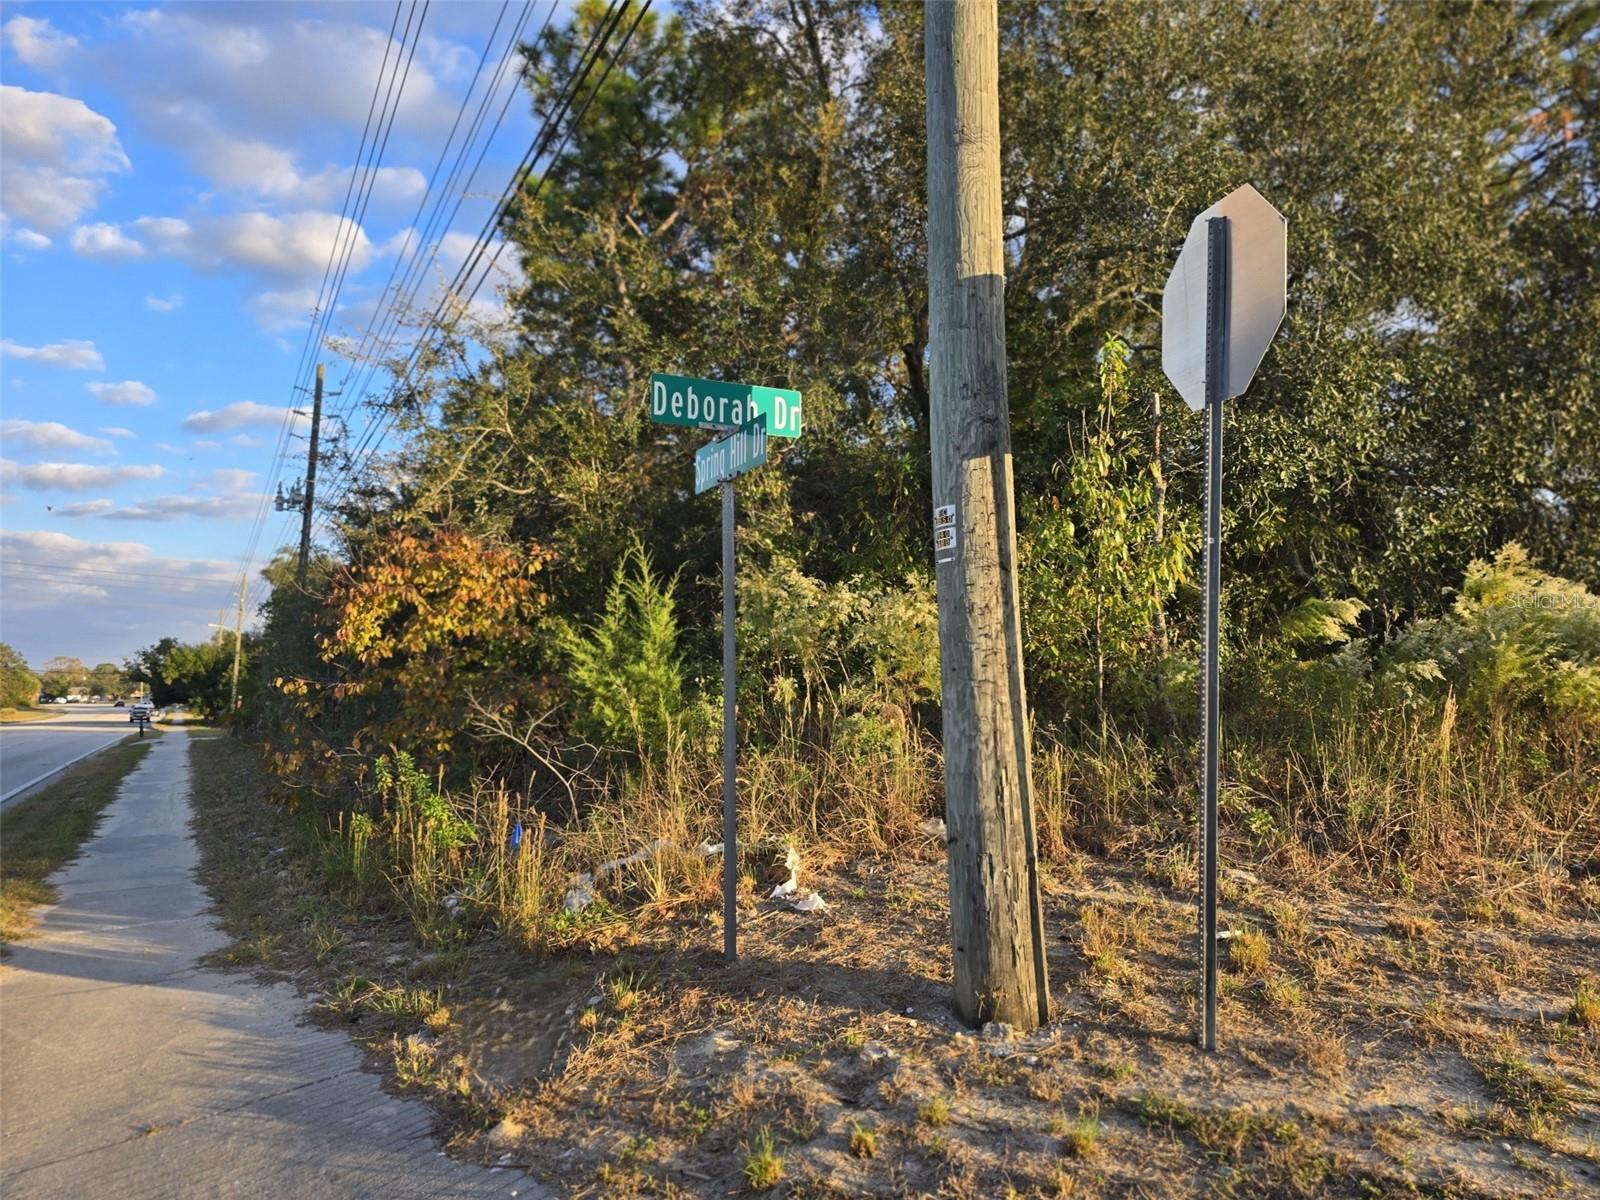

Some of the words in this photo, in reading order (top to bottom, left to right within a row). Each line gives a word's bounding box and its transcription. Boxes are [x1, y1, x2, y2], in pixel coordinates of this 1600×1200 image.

[653, 381, 758, 425] Deborah
[774, 396, 800, 431] Dr
[695, 447, 725, 491] Spring
[730, 429, 747, 469] Hill
[753, 423, 766, 458] Dr
